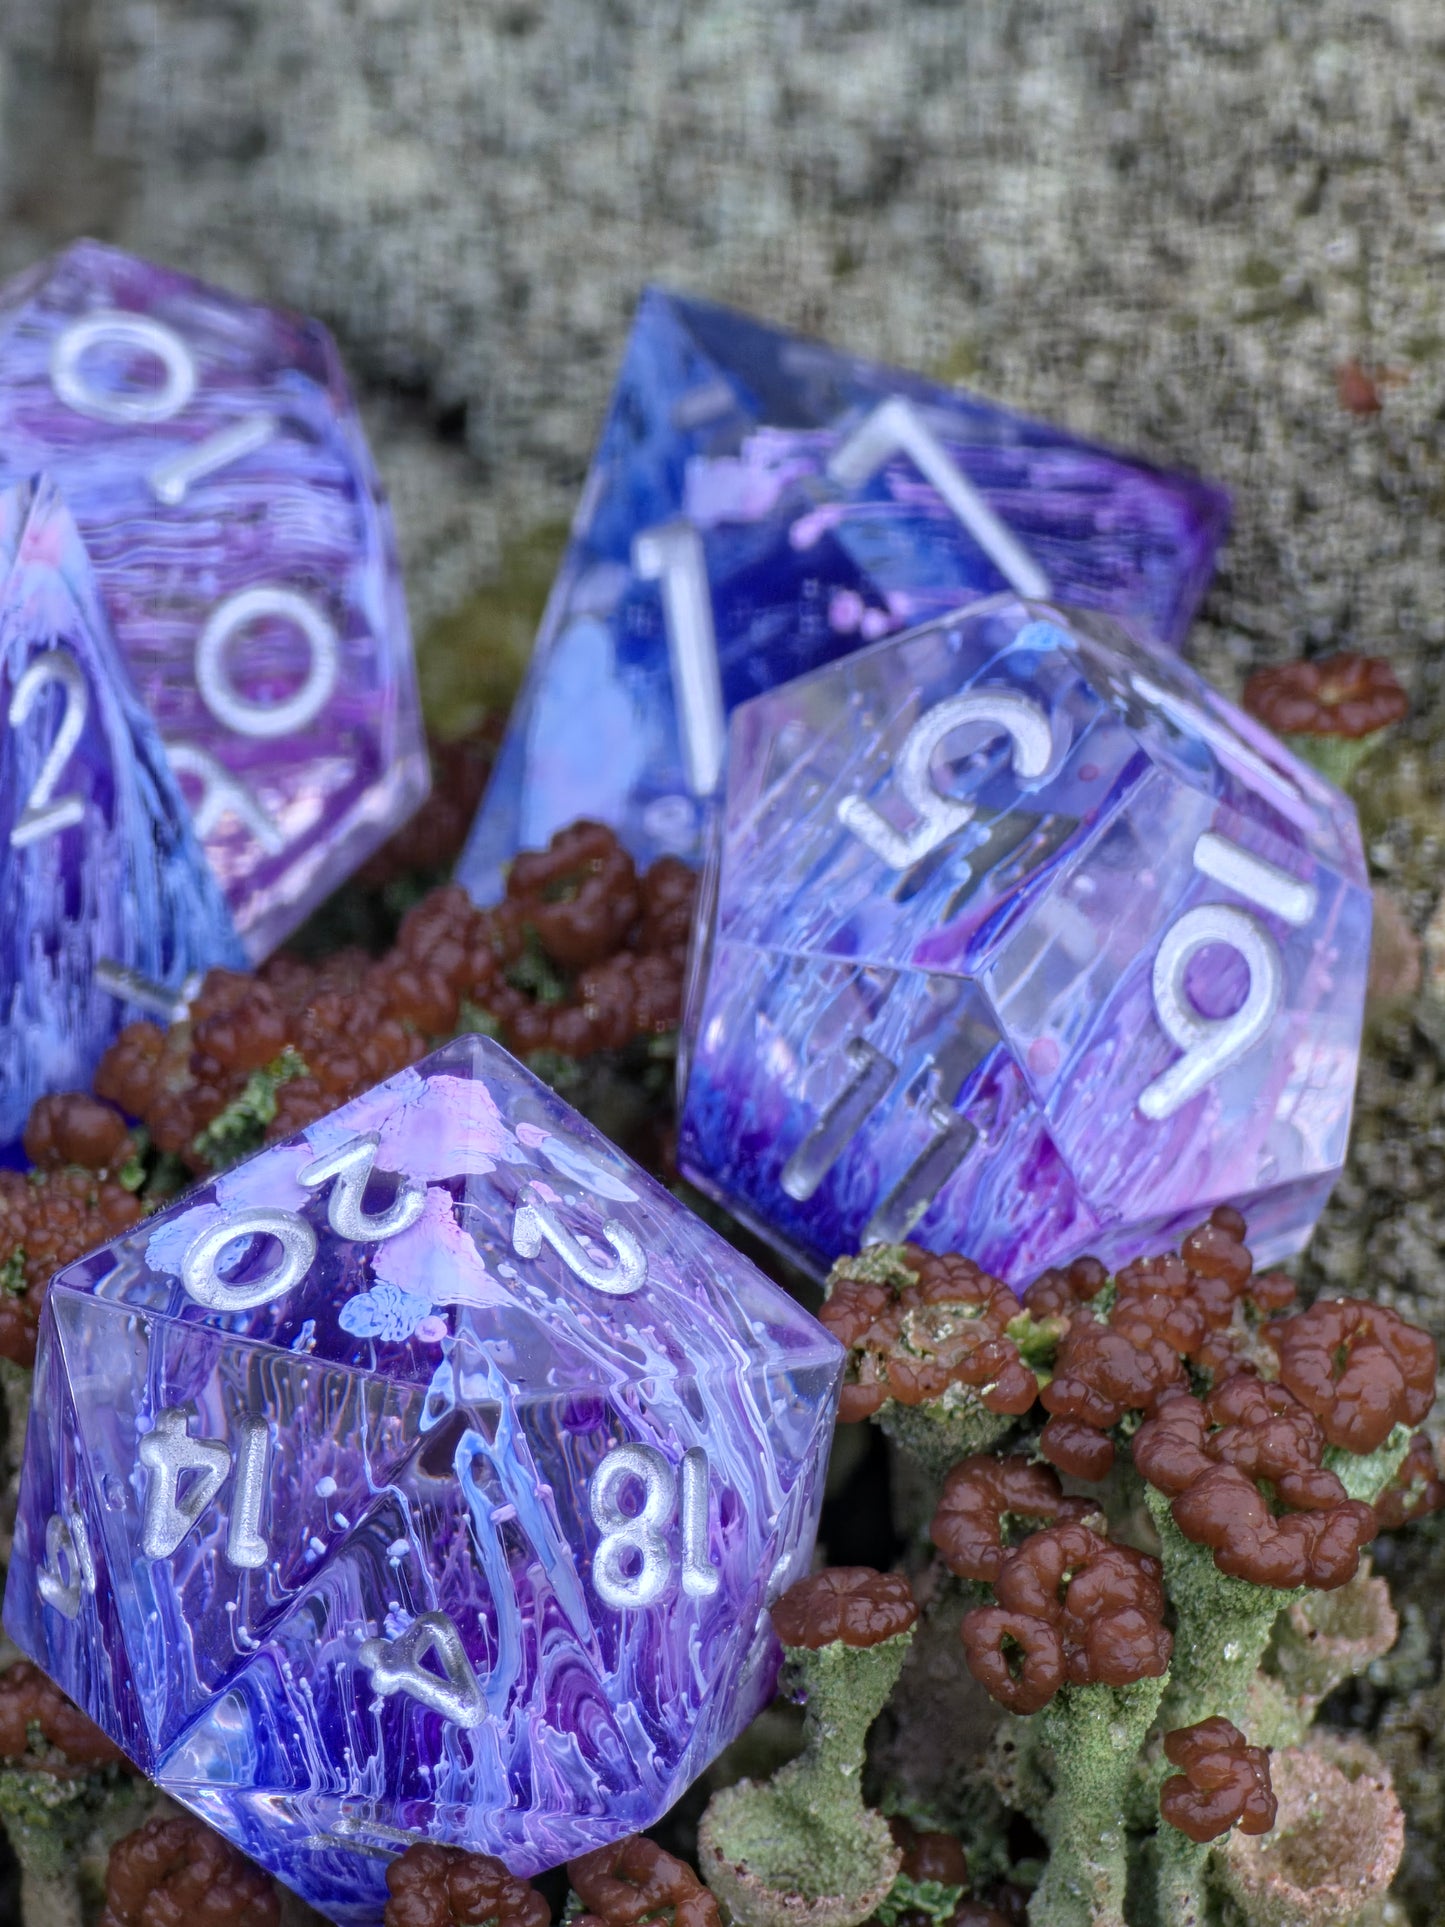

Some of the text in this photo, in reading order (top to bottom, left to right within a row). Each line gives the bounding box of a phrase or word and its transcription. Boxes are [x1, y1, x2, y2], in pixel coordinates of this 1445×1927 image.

[635, 522, 724, 796] 1
[10, 652, 87, 848] 2
[838, 692, 1053, 870] 5
[181, 1130, 428, 1312] 20
[513, 1184, 649, 1295] 2
[138, 1407, 271, 1570] 14
[590, 1441, 720, 1611] 18
[359, 1611, 489, 1729] 4
